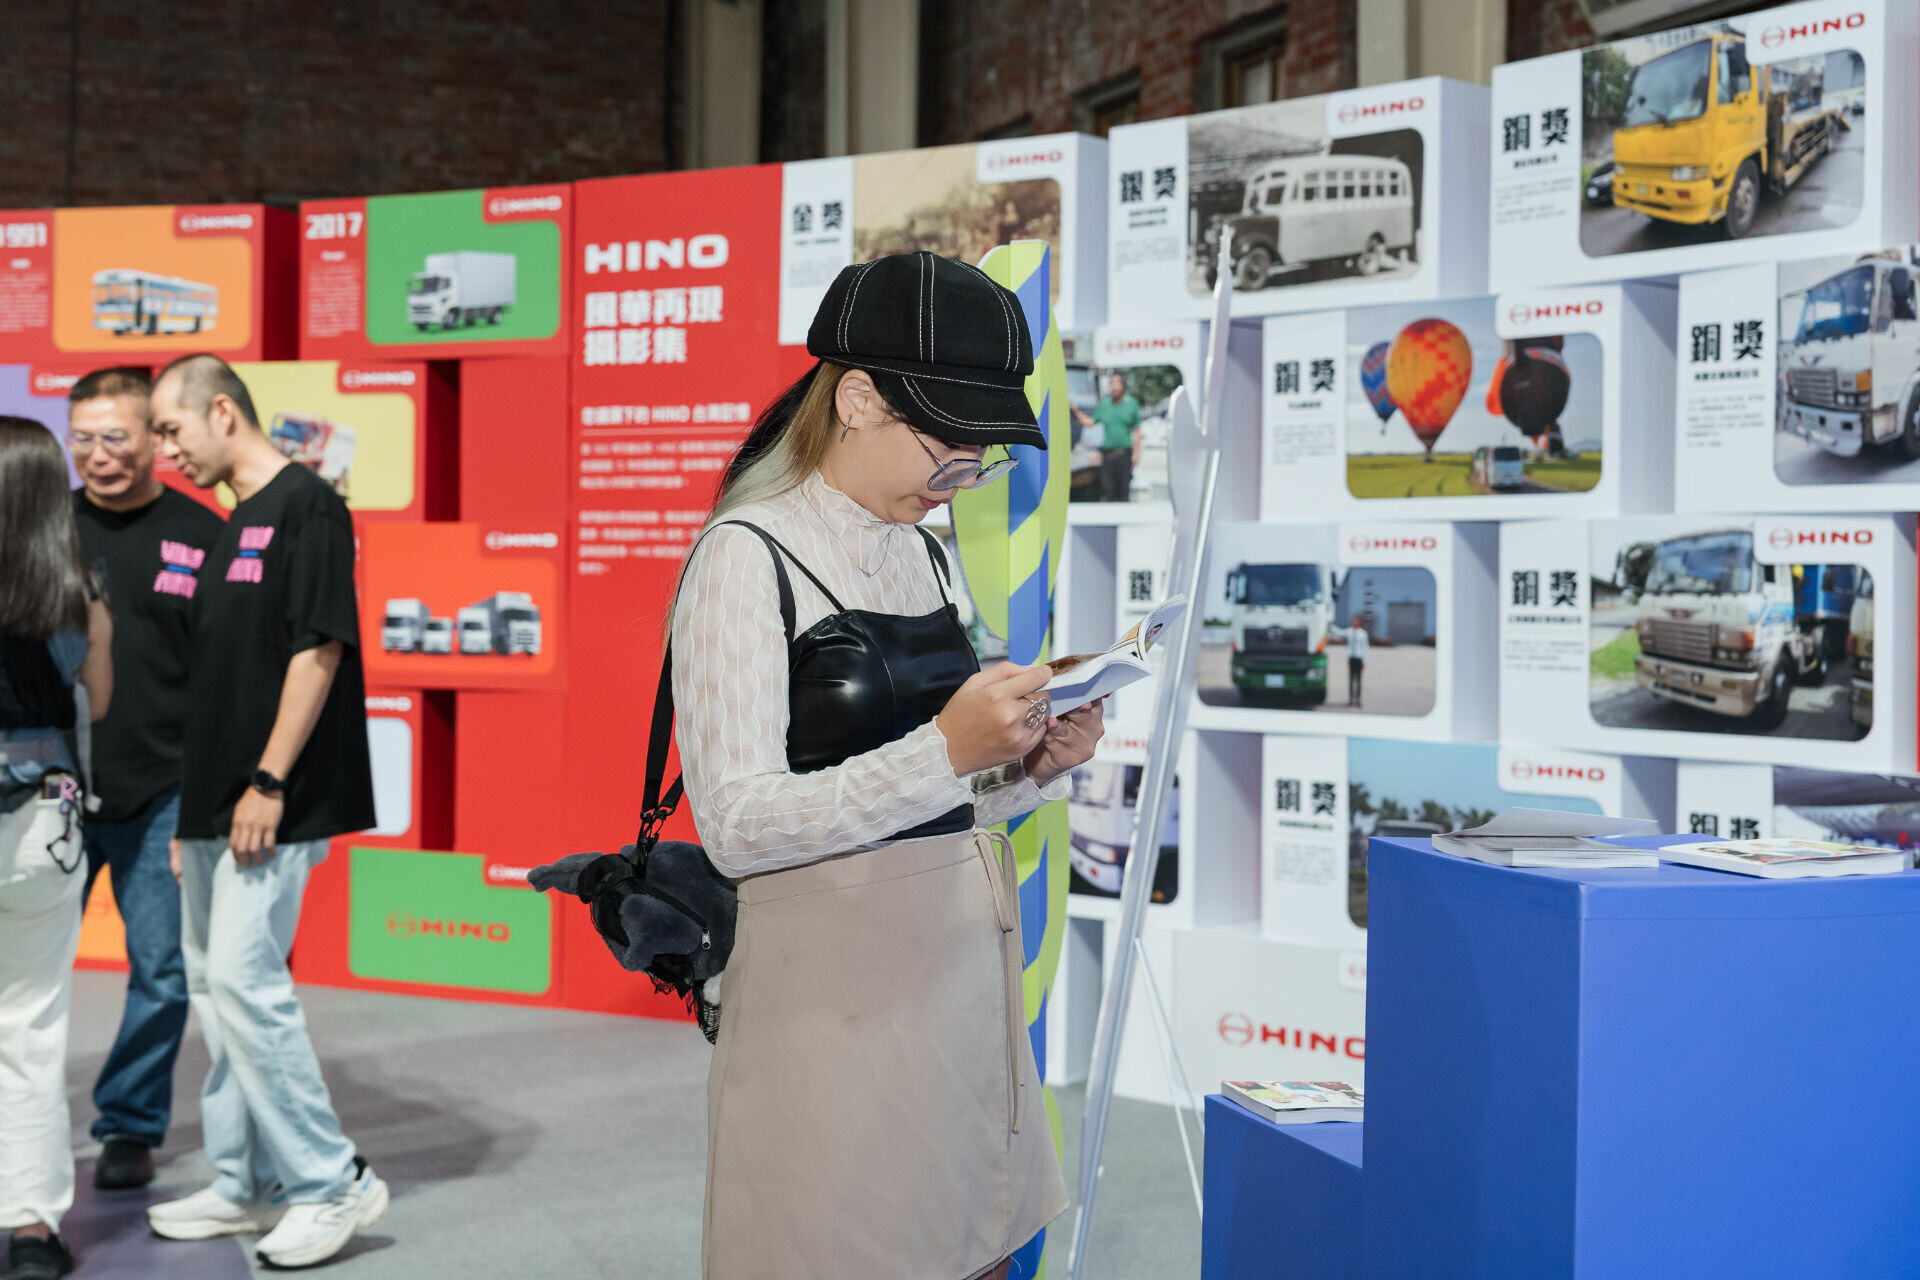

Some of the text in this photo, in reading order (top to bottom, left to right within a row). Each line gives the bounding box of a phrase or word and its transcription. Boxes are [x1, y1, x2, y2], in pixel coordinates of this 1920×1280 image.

[1789, 12, 1866, 39] HINO
[1362, 97, 1425, 118] HINO
[1503, 107, 1569, 153] 銅獎
[1006, 149, 1063, 166] HINO
[1119, 166, 1177, 204] 銀獎
[511, 195, 562, 212] HINO
[305, 211, 364, 239] 2017
[792, 202, 843, 233] 金獎
[584, 234, 729, 274] HINO
[584, 285, 724, 328] 風華再現
[1535, 301, 1604, 319] HINO
[1127, 336, 1184, 350] HINO
[1690, 319, 1763, 364] 銅獎
[1274, 358, 1336, 395] 銅獎
[651, 405, 691, 423] HINO
[505, 532, 559, 549] HINO
[1372, 536, 1438, 551] HINO
[1796, 529, 1873, 546] HINO
[1511, 570, 1578, 607] 銅獎
[1536, 764, 1606, 783] HINO
[1276, 778, 1337, 817] 銅獎
[420, 917, 511, 943] HINO
[1261, 1022, 1366, 1061] HINO
